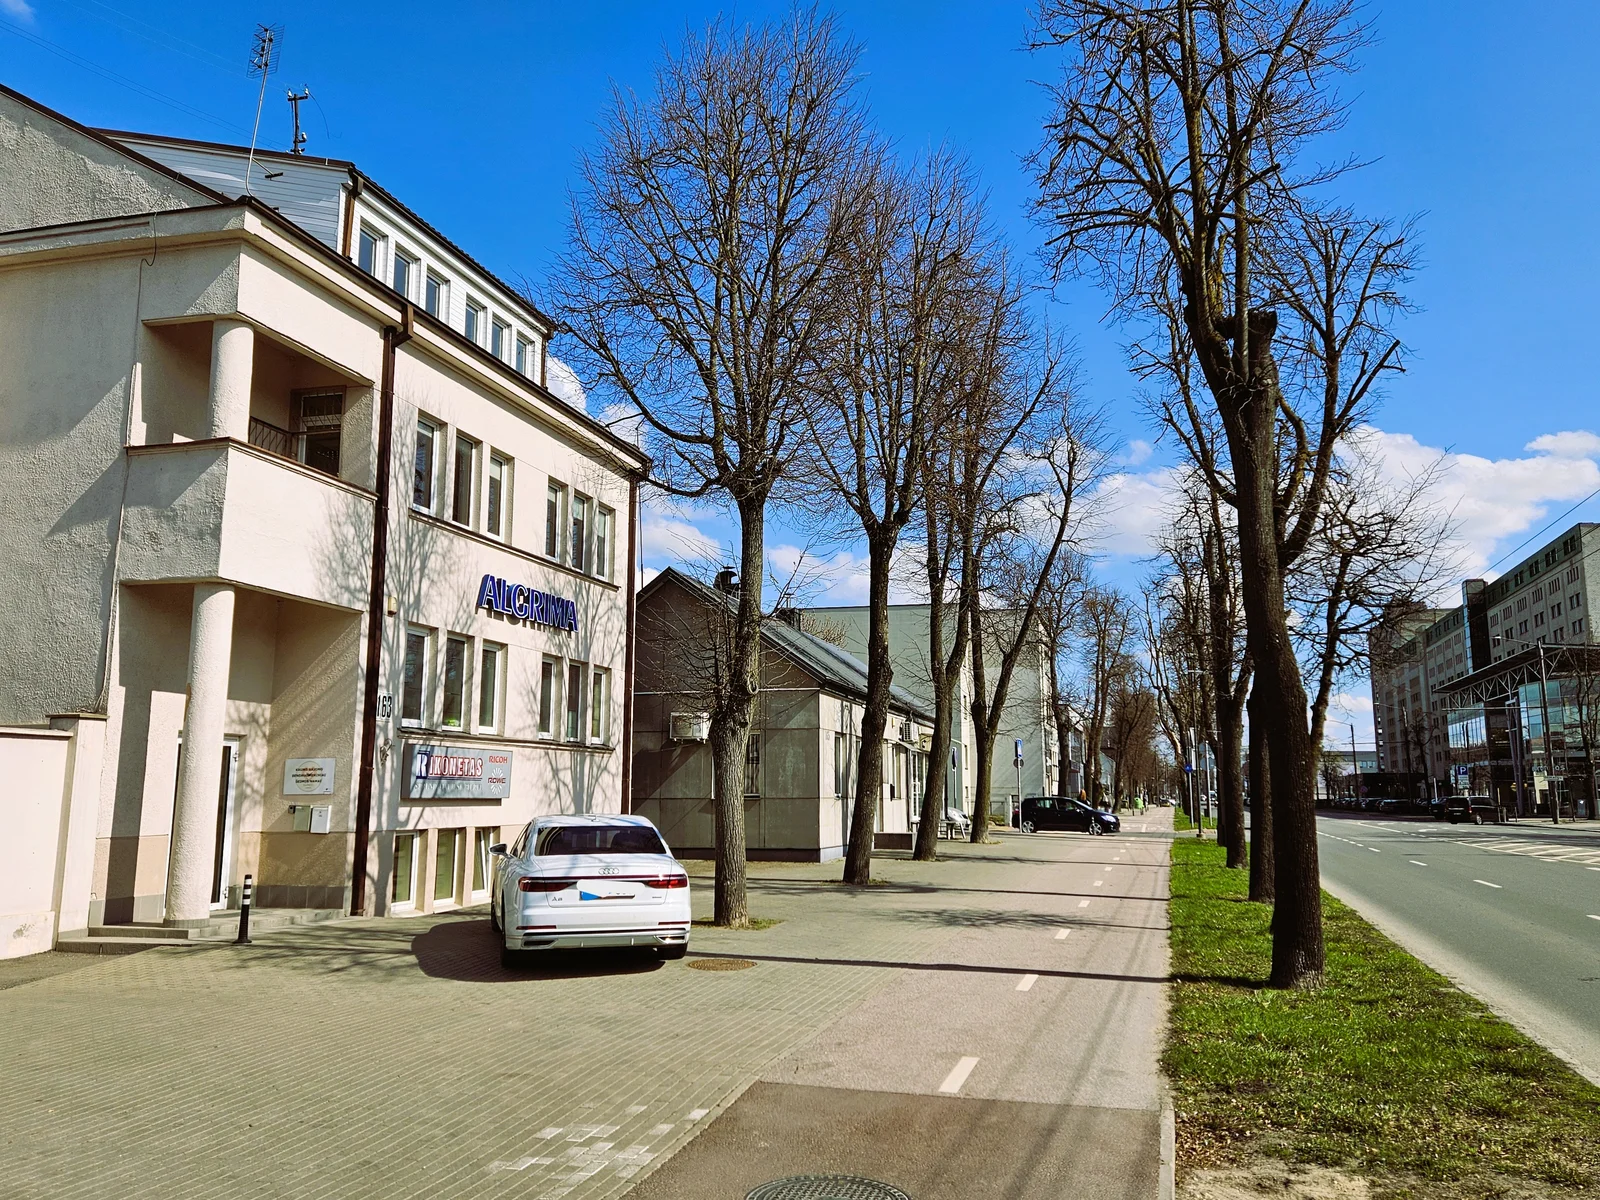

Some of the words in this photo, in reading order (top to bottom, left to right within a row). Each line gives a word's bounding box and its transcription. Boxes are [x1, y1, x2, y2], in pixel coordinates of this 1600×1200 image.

[478, 574, 578, 632] ALGRIMA
[376, 695, 393, 719] 163
[416, 753, 483, 777] RIKONETAS
[488, 755, 508, 764] RICOH
